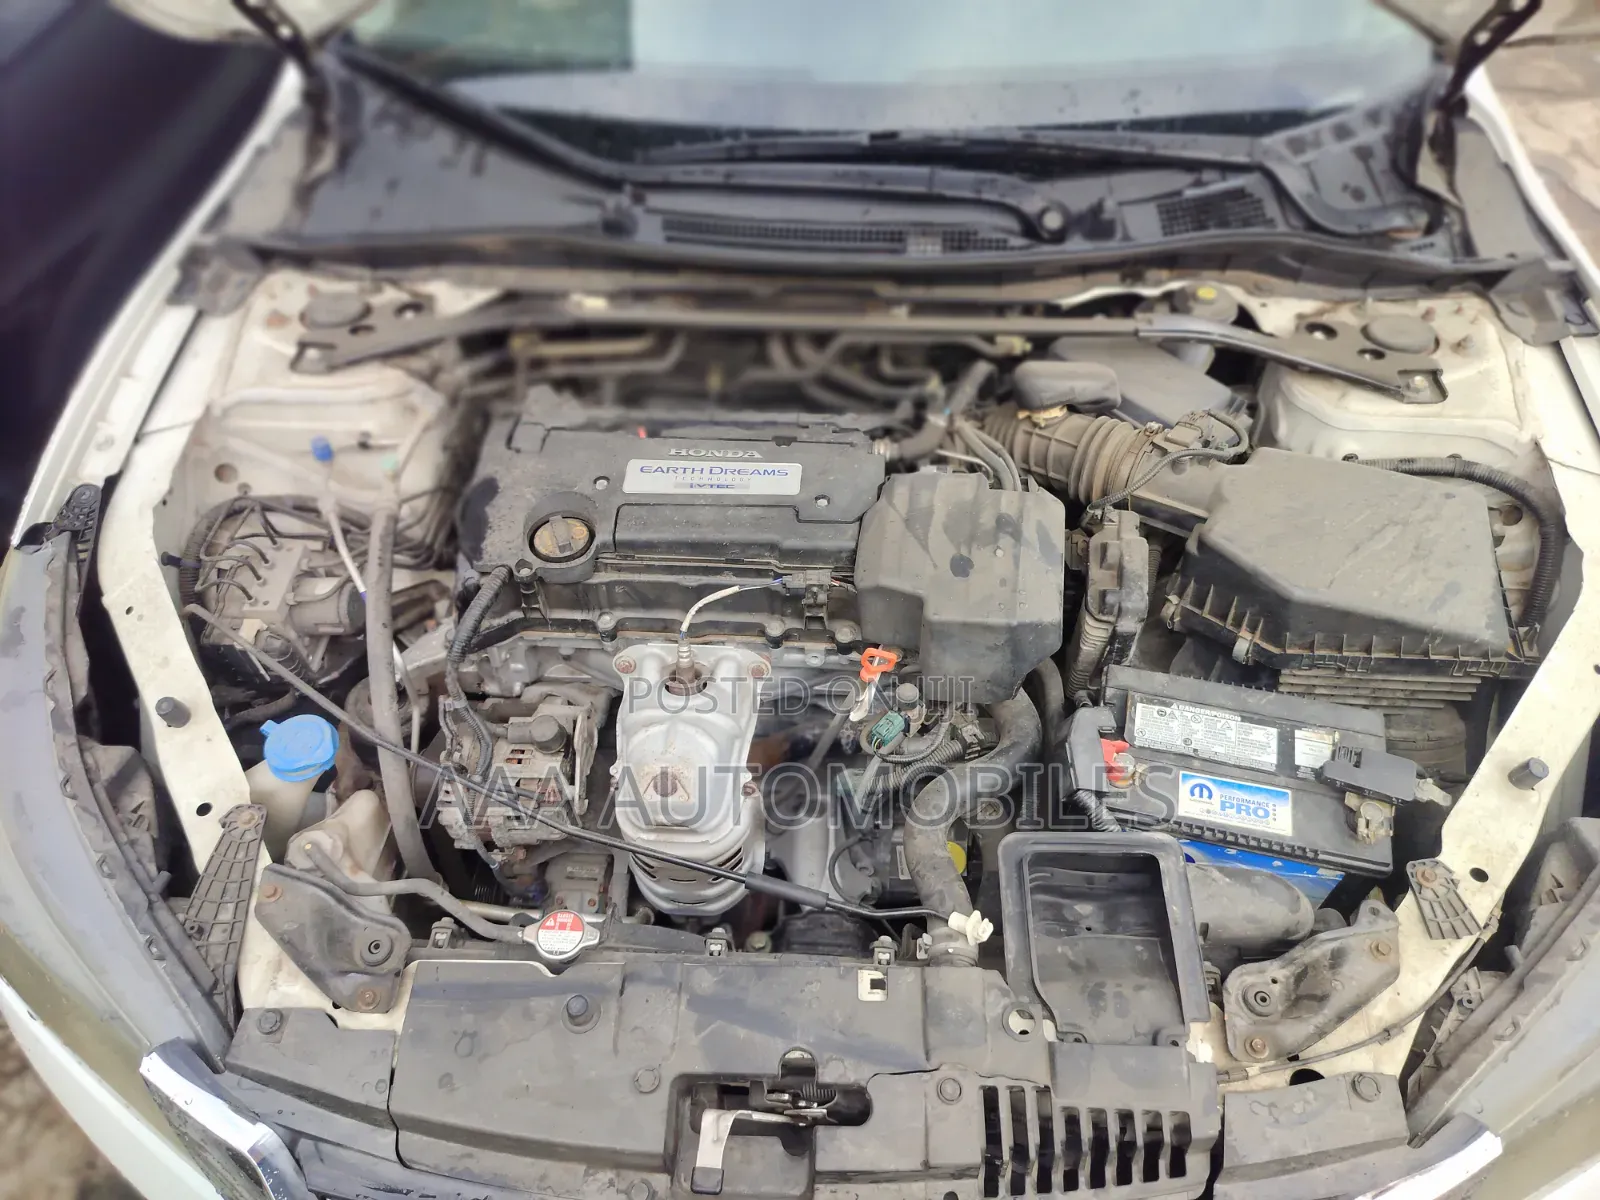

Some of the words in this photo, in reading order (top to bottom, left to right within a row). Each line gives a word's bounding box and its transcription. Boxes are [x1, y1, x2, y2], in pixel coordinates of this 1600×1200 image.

[668, 448, 763, 459] HONDA
[639, 465, 704, 475] EARTH
[708, 466, 789, 477] DREAMS
[1219, 793, 1270, 808] PERFORMANCE
[1219, 799, 1271, 820] PRO
